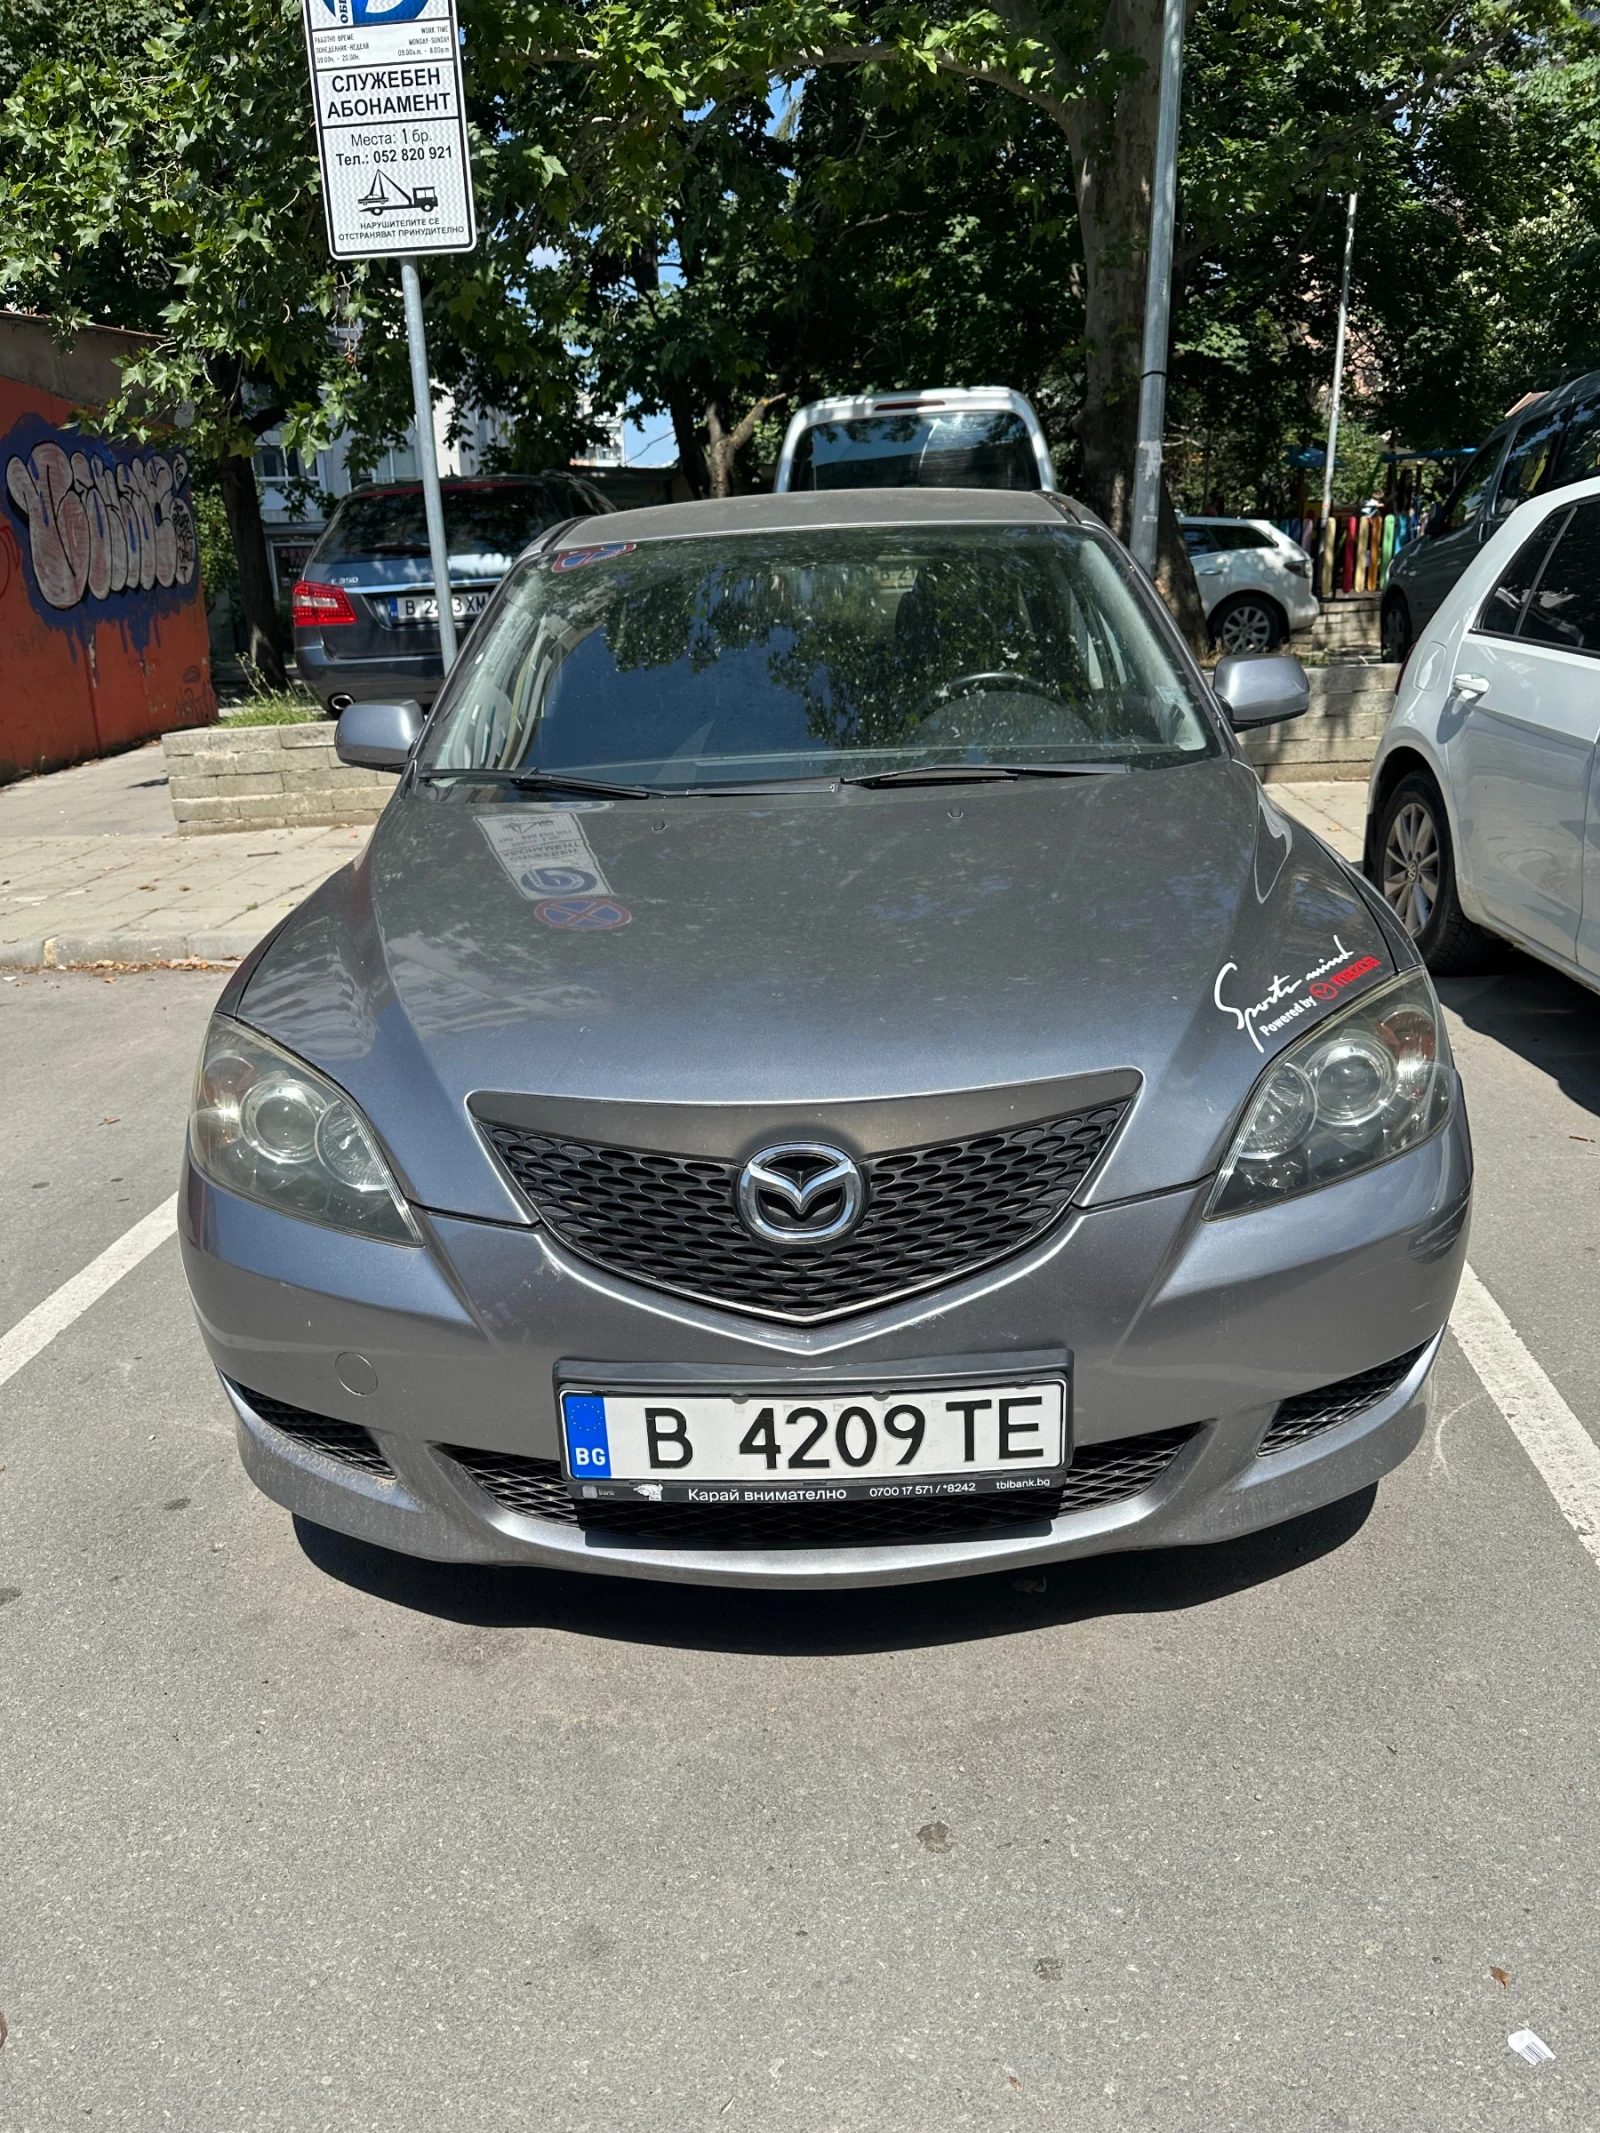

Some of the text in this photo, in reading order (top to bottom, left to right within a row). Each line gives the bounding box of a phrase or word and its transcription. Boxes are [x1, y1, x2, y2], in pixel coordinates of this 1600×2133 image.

[339, 0, 349, 24] ОБ
[421, 25, 449, 34] WORK TIME
[314, 34, 354, 44] РАБОТНО ВРЕМЕ
[408, 36, 450, 46] MONDAY-SUNDAY
[332, 67, 441, 93] СЛУЖЕБЕН
[327, 92, 451, 119] АБОНАМЕНТ
[350, 128, 433, 147] Места: 1 бр.
[335, 145, 452, 166] Тел.: 052 820 921
[360, 217, 440, 230] НАРУШИТЕЛИТЕ СЕ
[338, 225, 465, 241] ОТСТРАНЯВАТ ПРИНУДИТЕЛНО
[424, 598, 462, 615] 23
[1259, 1004, 1304, 1037] Powered
[1302, 995, 1318, 1010] by
[644, 1395, 1045, 1471] B 4209 TE
[575, 1446, 606, 1467] BG
[688, 1488, 848, 1503] Карай внимателно
[869, 1487, 899, 1498] 0700
[902, 1486, 912, 1496] 17
[915, 1485, 934, 1495] 571
